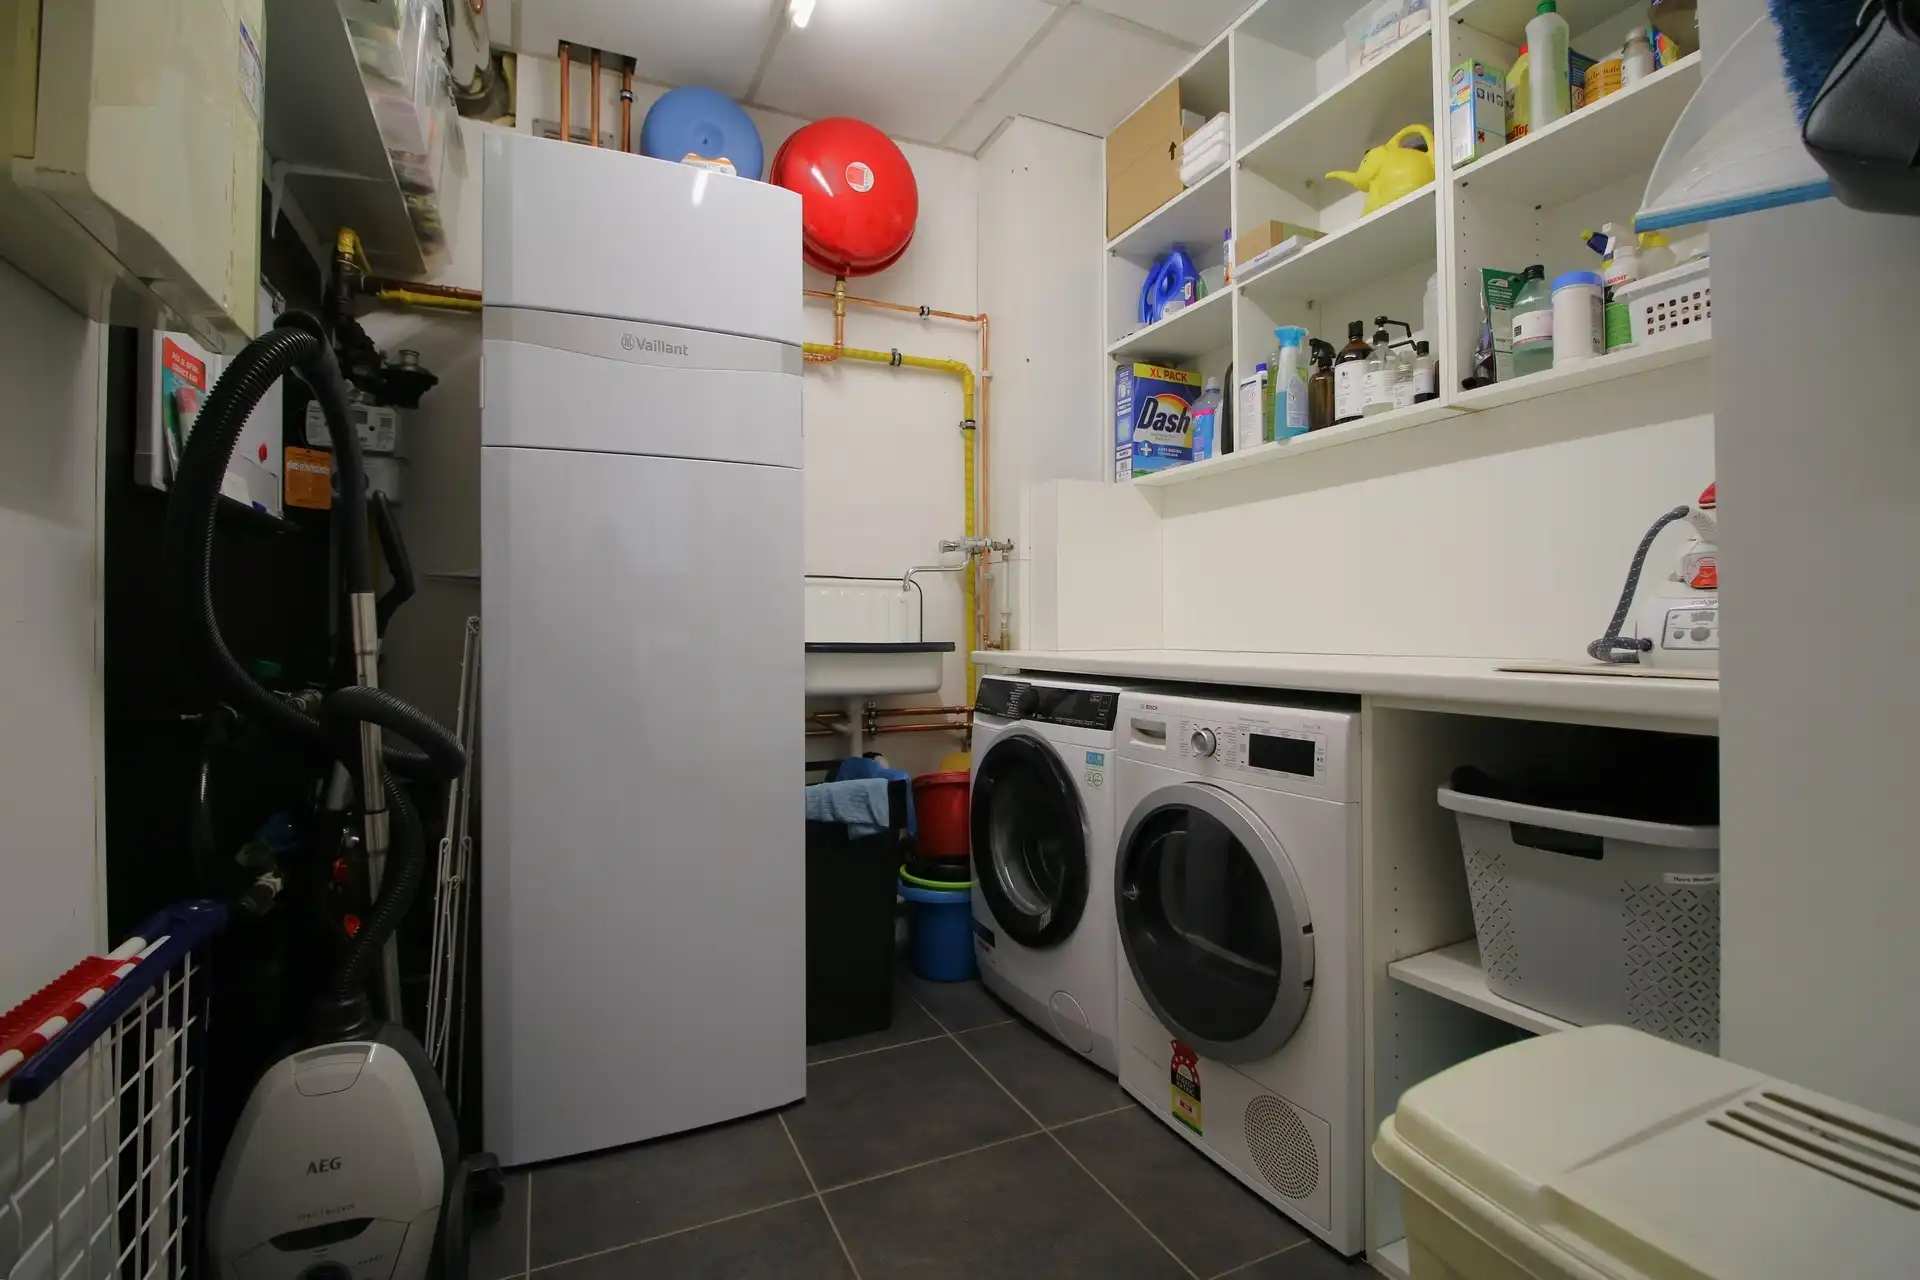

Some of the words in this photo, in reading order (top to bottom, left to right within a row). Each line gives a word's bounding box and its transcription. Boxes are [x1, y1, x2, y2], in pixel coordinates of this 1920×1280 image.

[636, 336, 690, 357] Vaillant
[1150, 367, 1162, 378] XL
[1163, 370, 1189, 382] PACK
[1137, 396, 1192, 435] Dash
[306, 1156, 342, 1176] AEG
